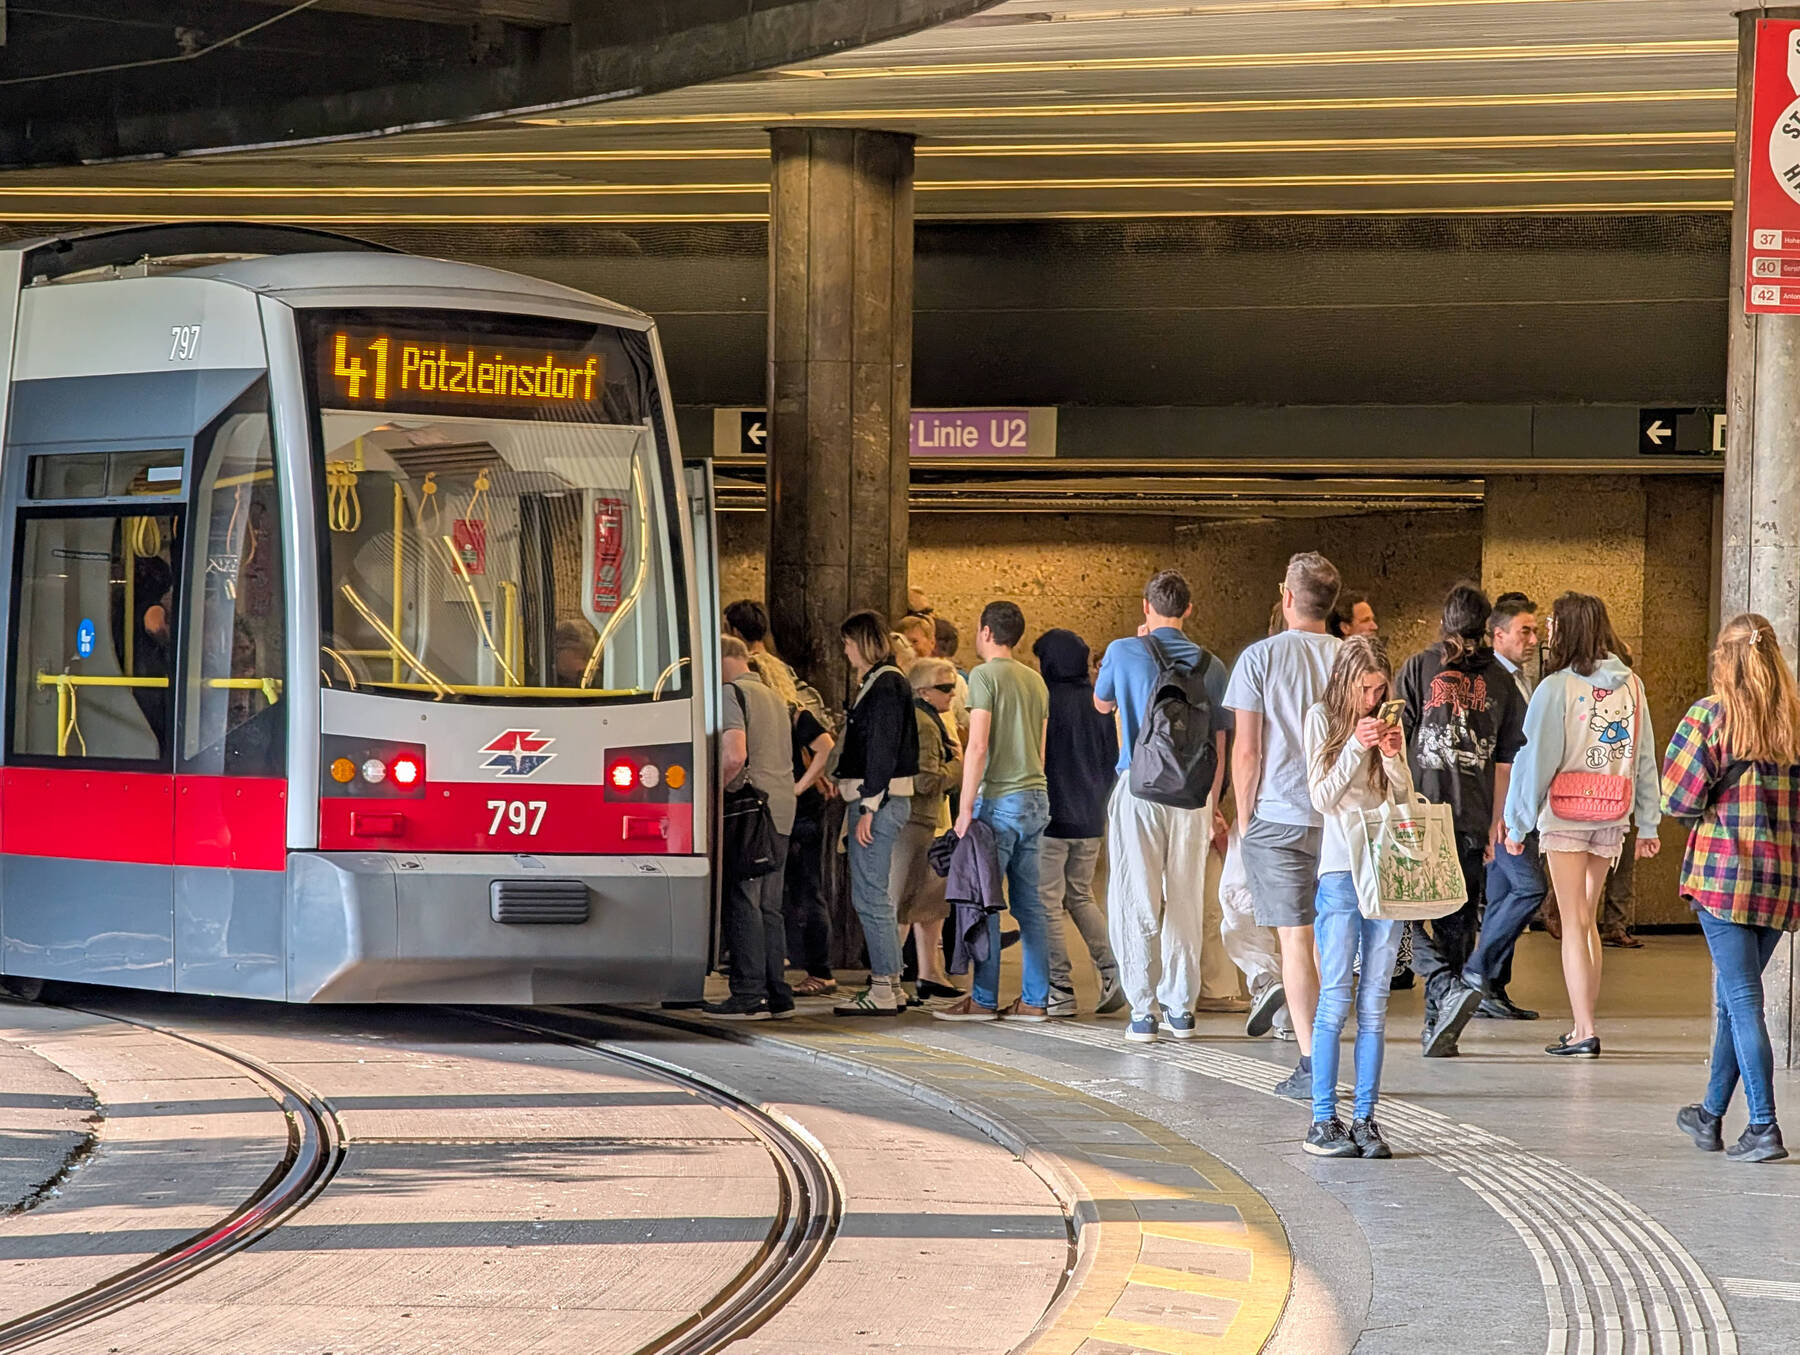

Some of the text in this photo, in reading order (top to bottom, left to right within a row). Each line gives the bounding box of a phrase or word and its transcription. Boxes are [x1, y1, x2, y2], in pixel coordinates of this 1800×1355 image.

[1760, 234, 1776, 245] 37
[1758, 262, 1776, 273] 40
[1757, 290, 1775, 301] 42
[169, 325, 201, 361] 797
[334, 335, 598, 401] 41 Pötzleinsdorf
[918, 419, 979, 448] Linie
[990, 418, 1027, 448] U2
[487, 800, 548, 836] 797
